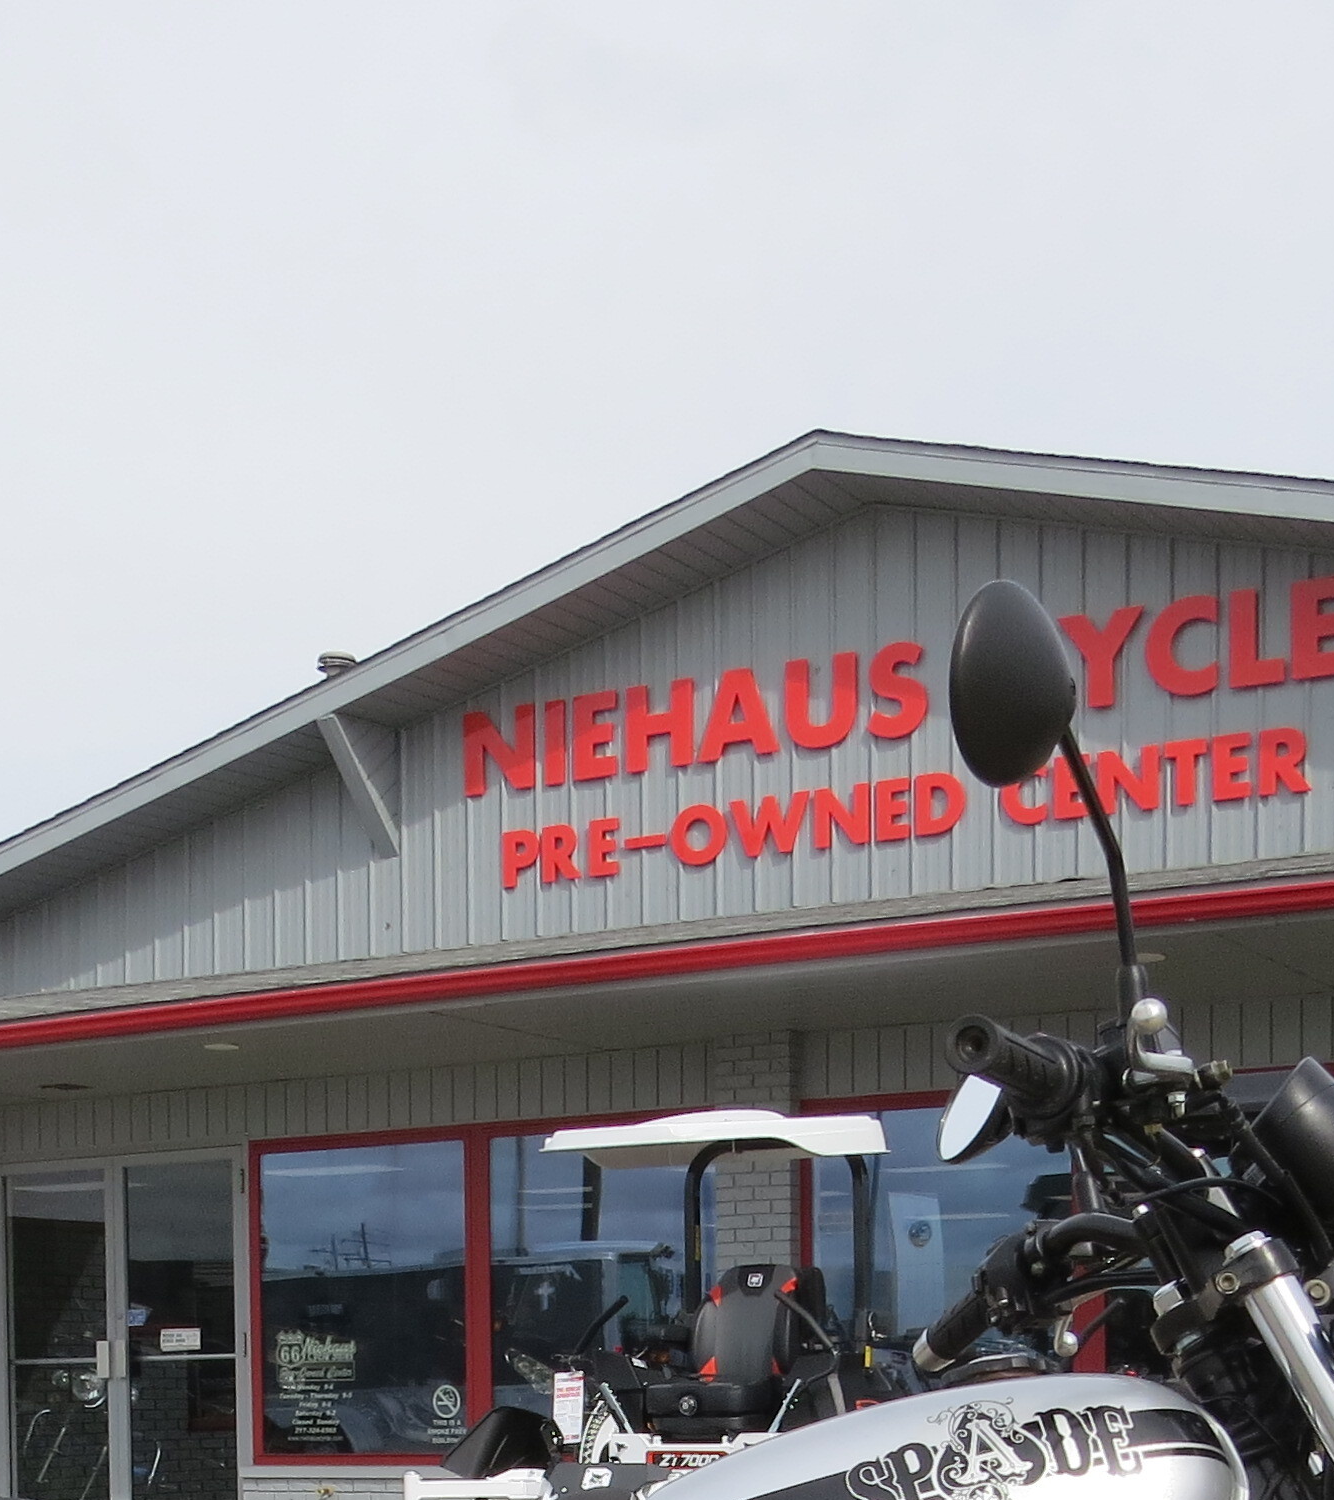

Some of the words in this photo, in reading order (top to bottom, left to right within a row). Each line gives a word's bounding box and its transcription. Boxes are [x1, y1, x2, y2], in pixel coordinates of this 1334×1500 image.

[462, 640, 929, 798] NIEHAUS
[501, 771, 965, 891] PRE-OWNED
[999, 726, 1312, 825] CENTER
[280, 1346, 301, 1363] 66
